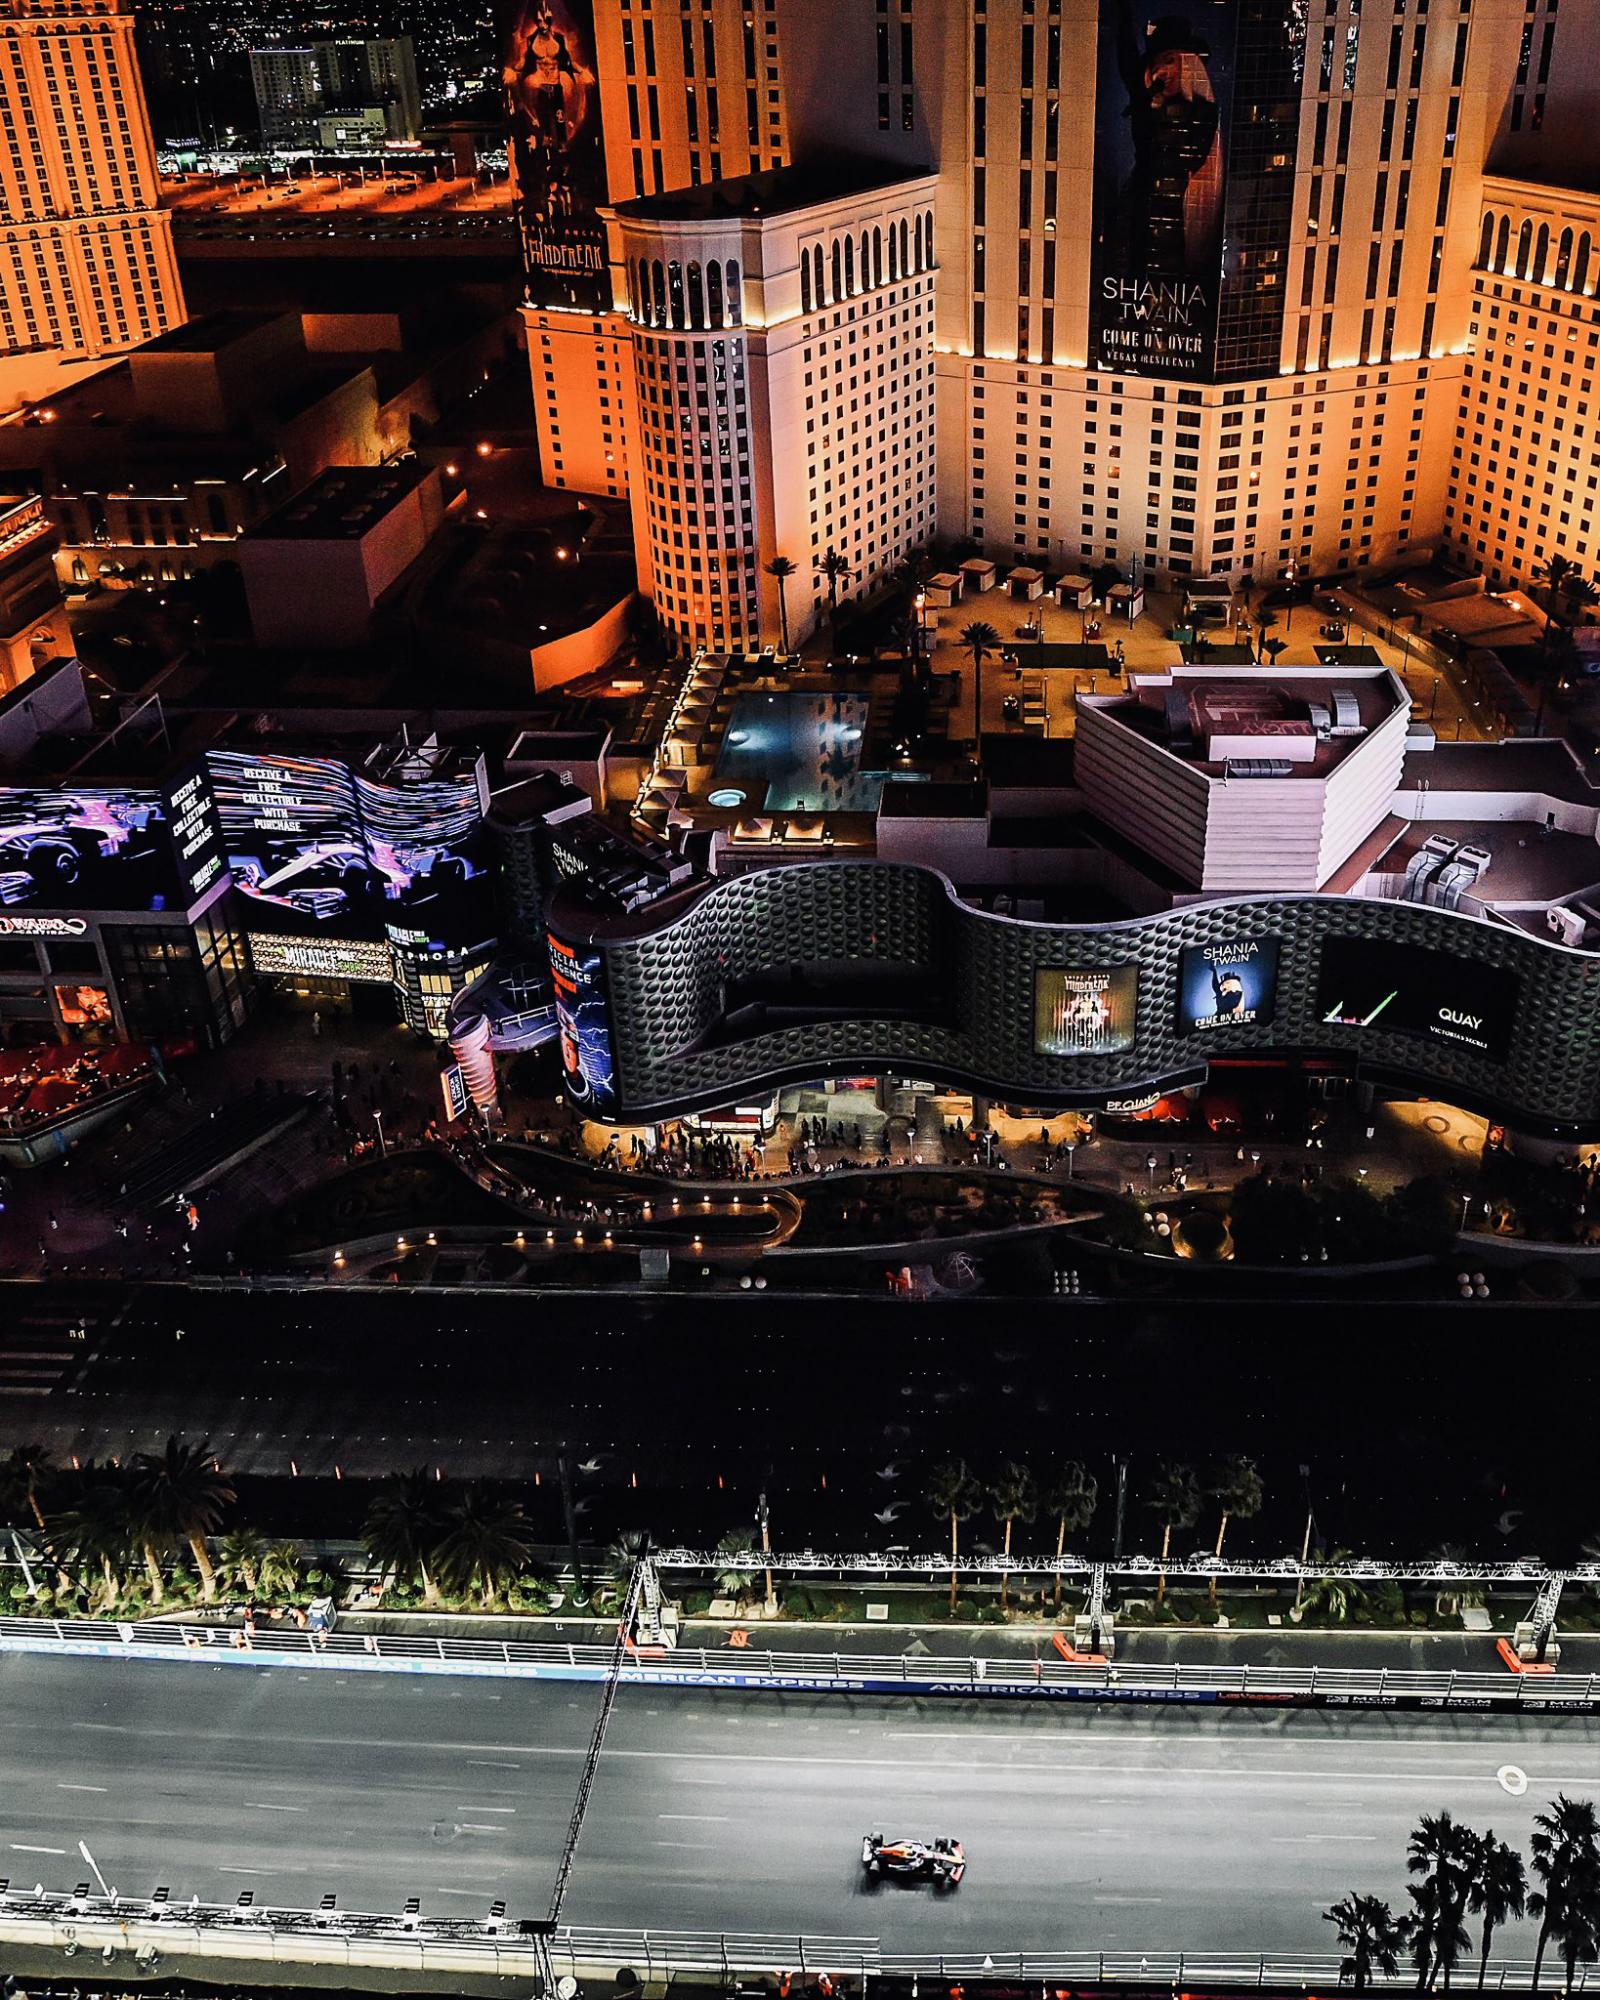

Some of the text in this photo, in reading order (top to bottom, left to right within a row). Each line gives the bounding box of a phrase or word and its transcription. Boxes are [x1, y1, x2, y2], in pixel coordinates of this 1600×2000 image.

[528, 239, 604, 270] MINDFREAK
[1103, 277, 1206, 307] SHANIA
[1120, 302, 1189, 325] TWAIN
[1103, 328, 1202, 353] COME ON OVER
[1106, 350, 1196, 368] VEGAS RESIDENCY
[243, 768, 292, 782] RECEIVE A
[170, 774, 203, 808] RECEIVE A
[258, 782, 282, 793] FREE
[181, 793, 198, 814] FREE
[242, 793, 303, 807] COLLECTIBLE
[172, 796, 212, 837] COLLECTIBLE
[262, 807, 288, 818] WITH
[186, 818, 204, 840] WITH
[254, 818, 302, 832] PURCHASE
[182, 825, 214, 860] PURCHASE
[552, 842, 588, 872] SHANI
[284, 946, 338, 970] MIRACLE
[388, 946, 469, 962] SEPHORA
[1203, 941, 1259, 960] SHANIA
[1212, 953, 1250, 967] TWAIN
[1195, 1015, 1218, 1027] COME
[1220, 1013, 1233, 1022] ON
[1234, 1010, 1256, 1020] OVER
[1439, 1008, 1483, 1030] QUAY
[1430, 1025, 1465, 1041] VICTORIAS
[281, 1656, 538, 1677] AMERICAN EXPRESS
[600, 1671, 865, 1688] AMERICAN EXPRESS
[929, 1684, 1201, 1698] AMERICAN EXPRESS
